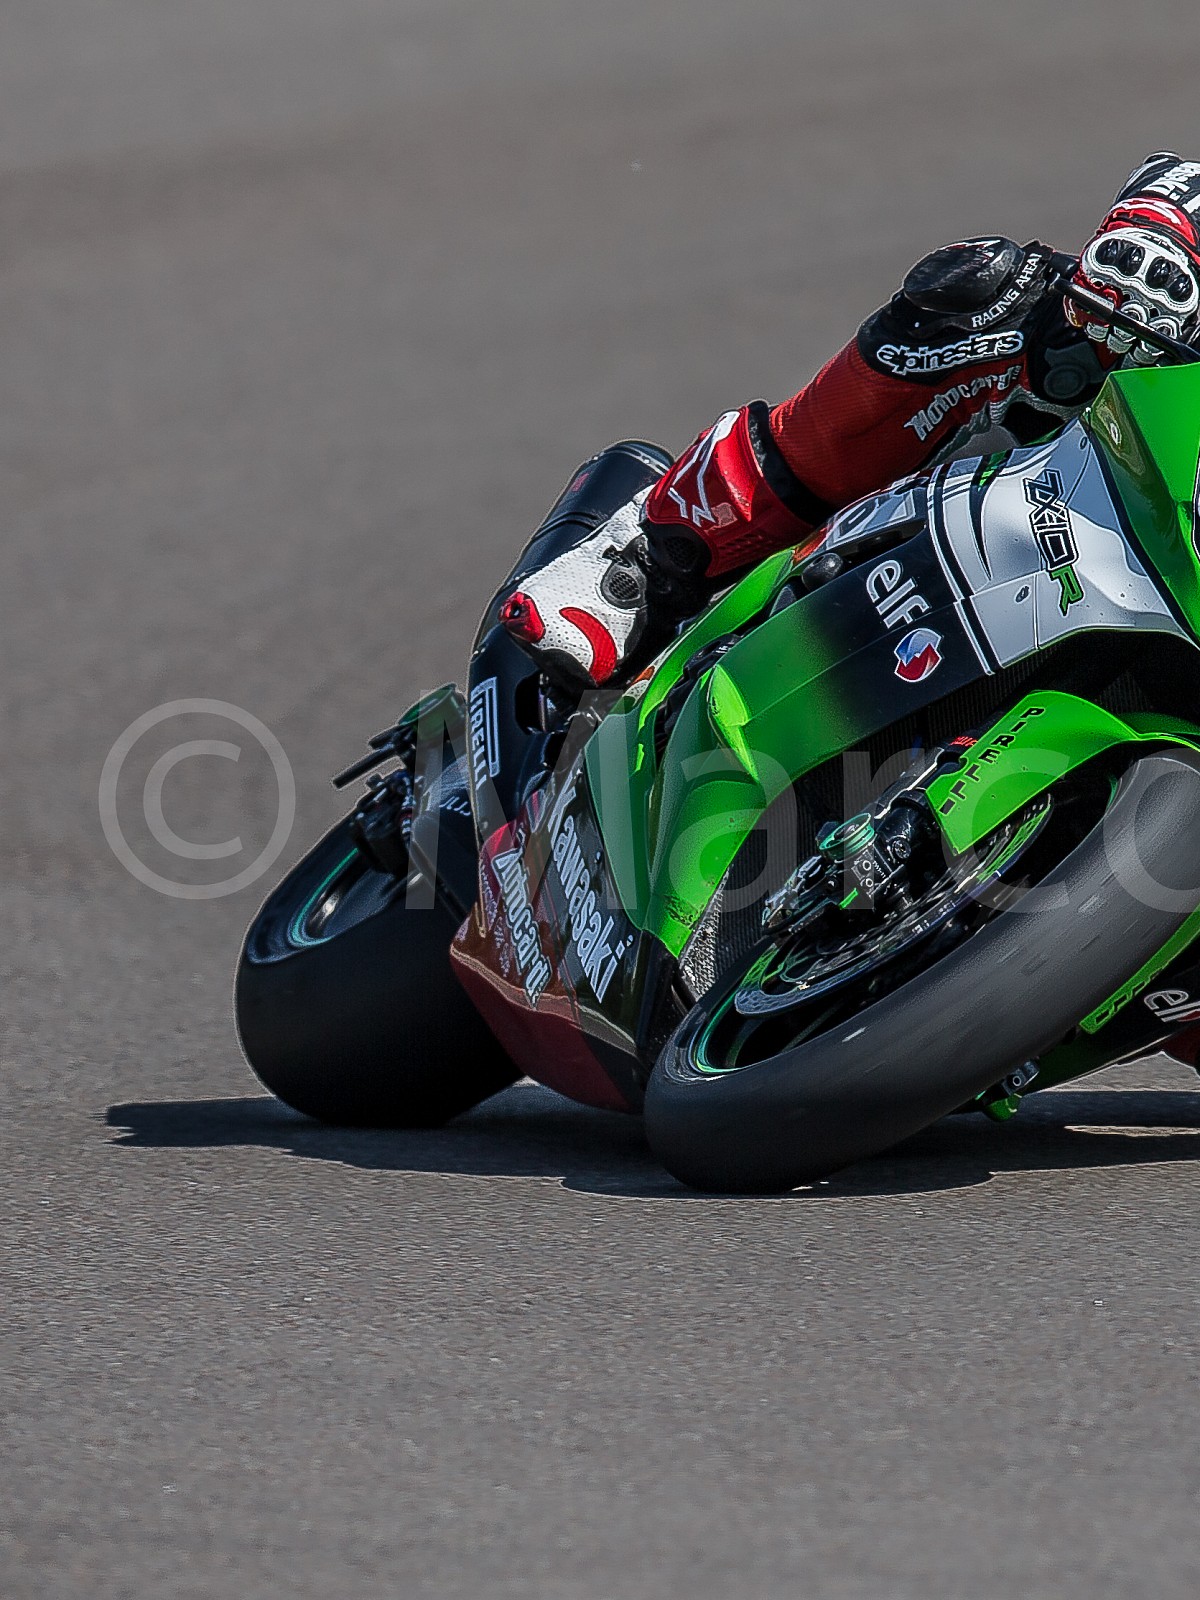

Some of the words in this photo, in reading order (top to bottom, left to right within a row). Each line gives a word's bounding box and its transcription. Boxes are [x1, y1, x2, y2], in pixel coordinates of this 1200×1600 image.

[971, 288, 1020, 328] RACING
[865, 559, 932, 629] elf
[470, 676, 500, 791] PIRELLI
[938, 707, 1046, 816] PIRELLI
[548, 770, 634, 1004] Kawasaki
